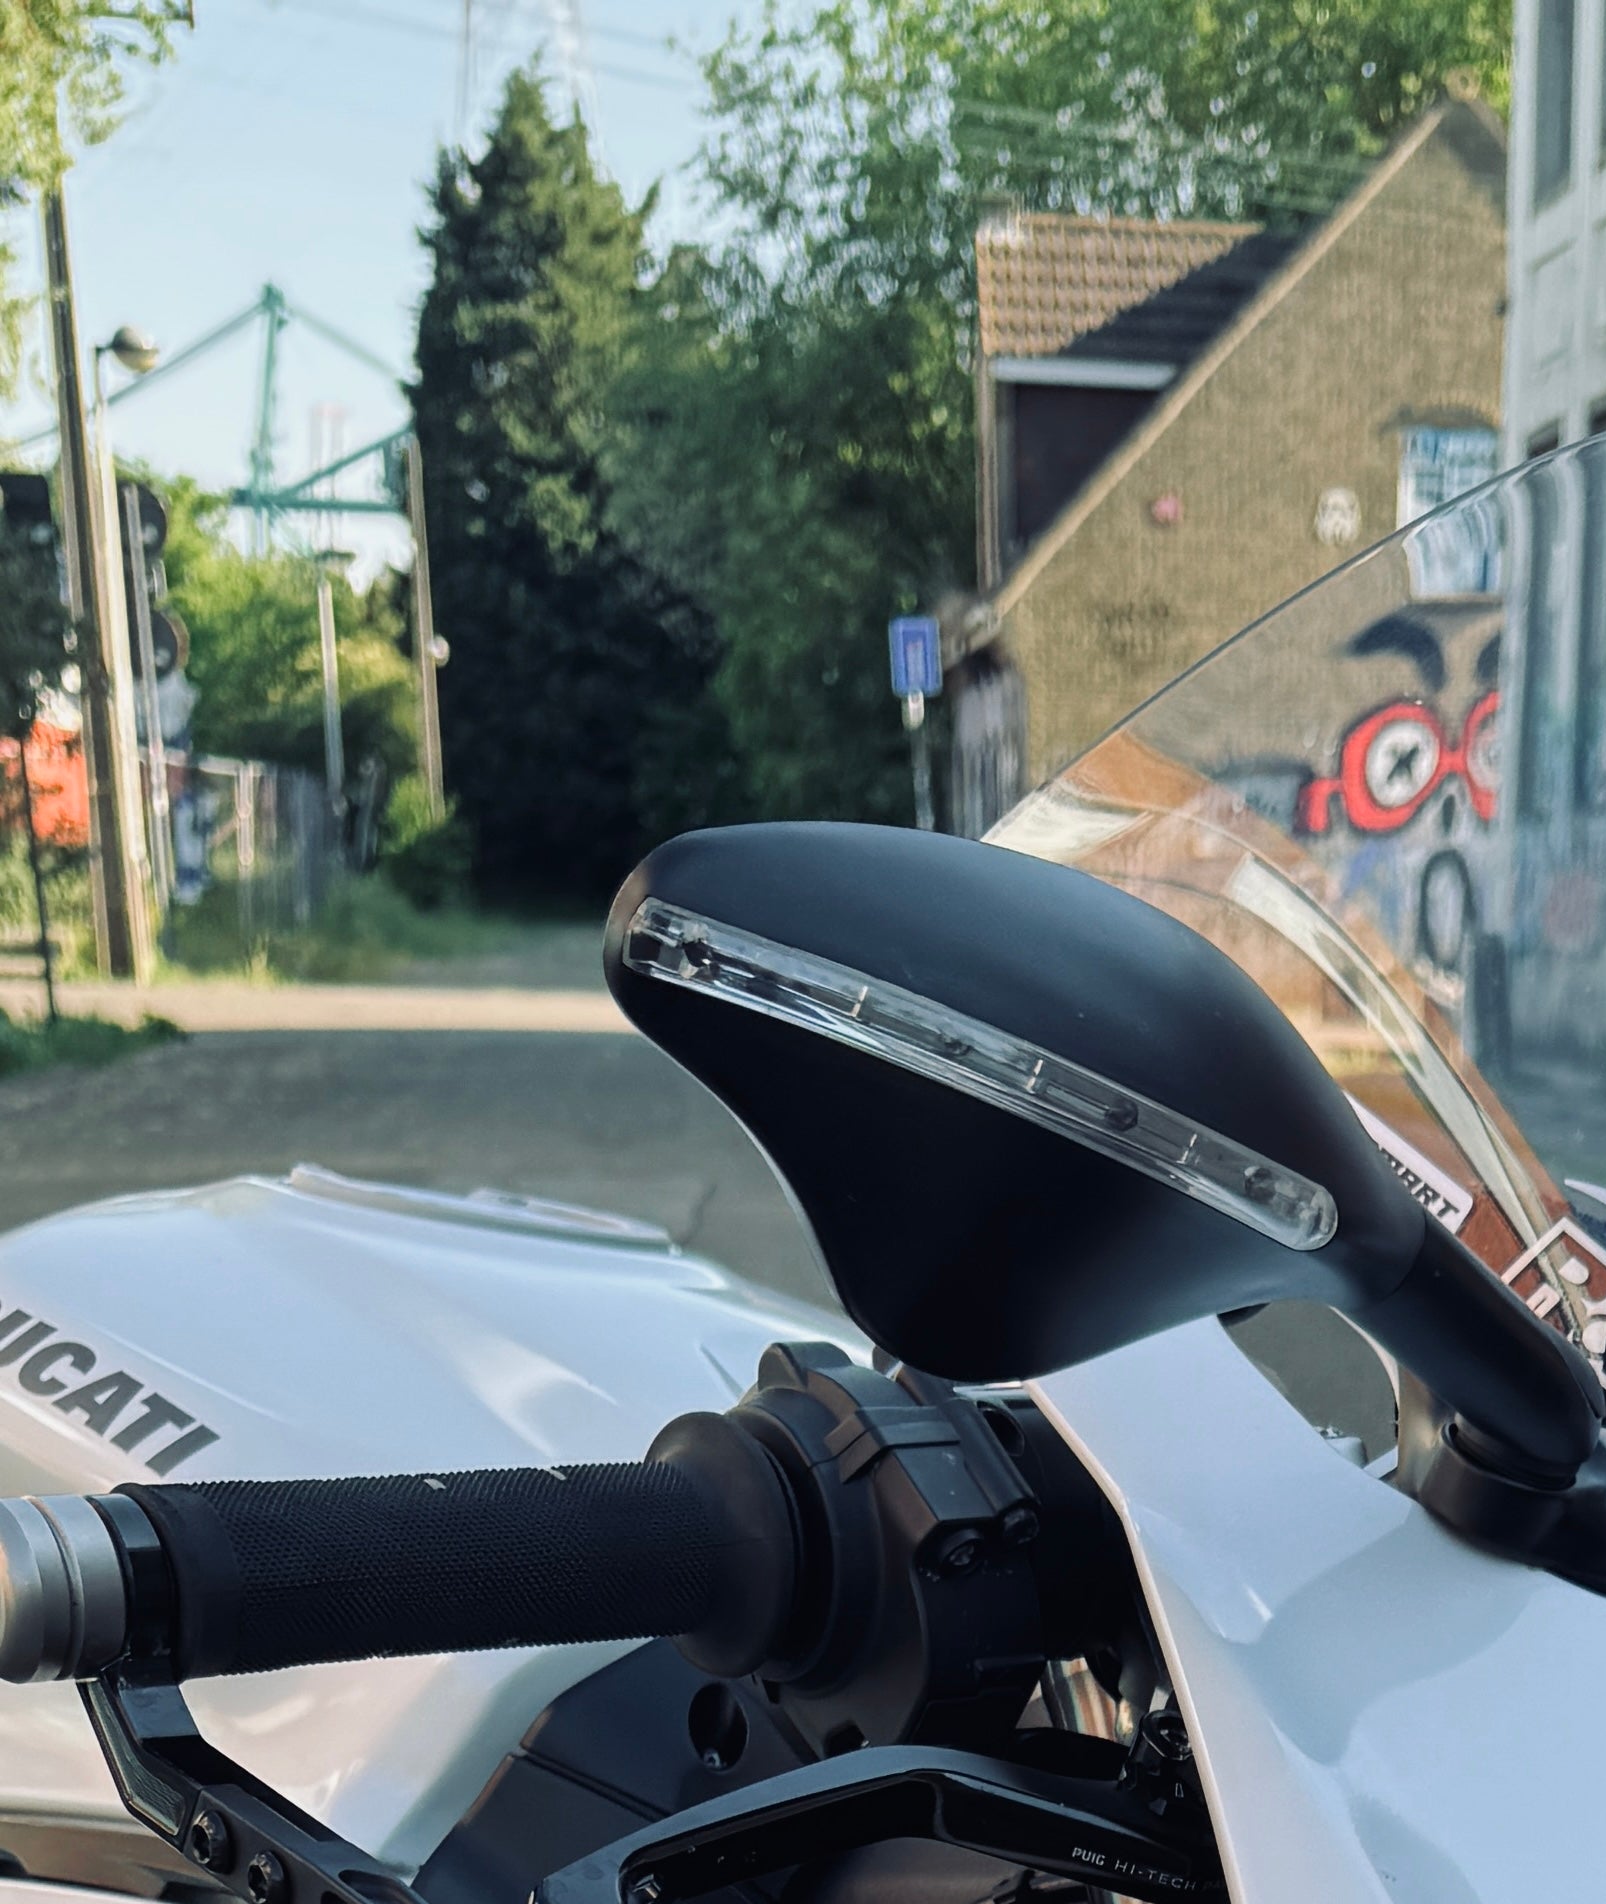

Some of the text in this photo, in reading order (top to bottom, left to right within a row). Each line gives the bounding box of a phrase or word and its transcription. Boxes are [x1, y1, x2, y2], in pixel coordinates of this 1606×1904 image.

[0, 1303, 221, 1477] UCATI
[1072, 1847, 1106, 1866] PUIG
[1114, 1859, 1198, 1891] HI-TECH
